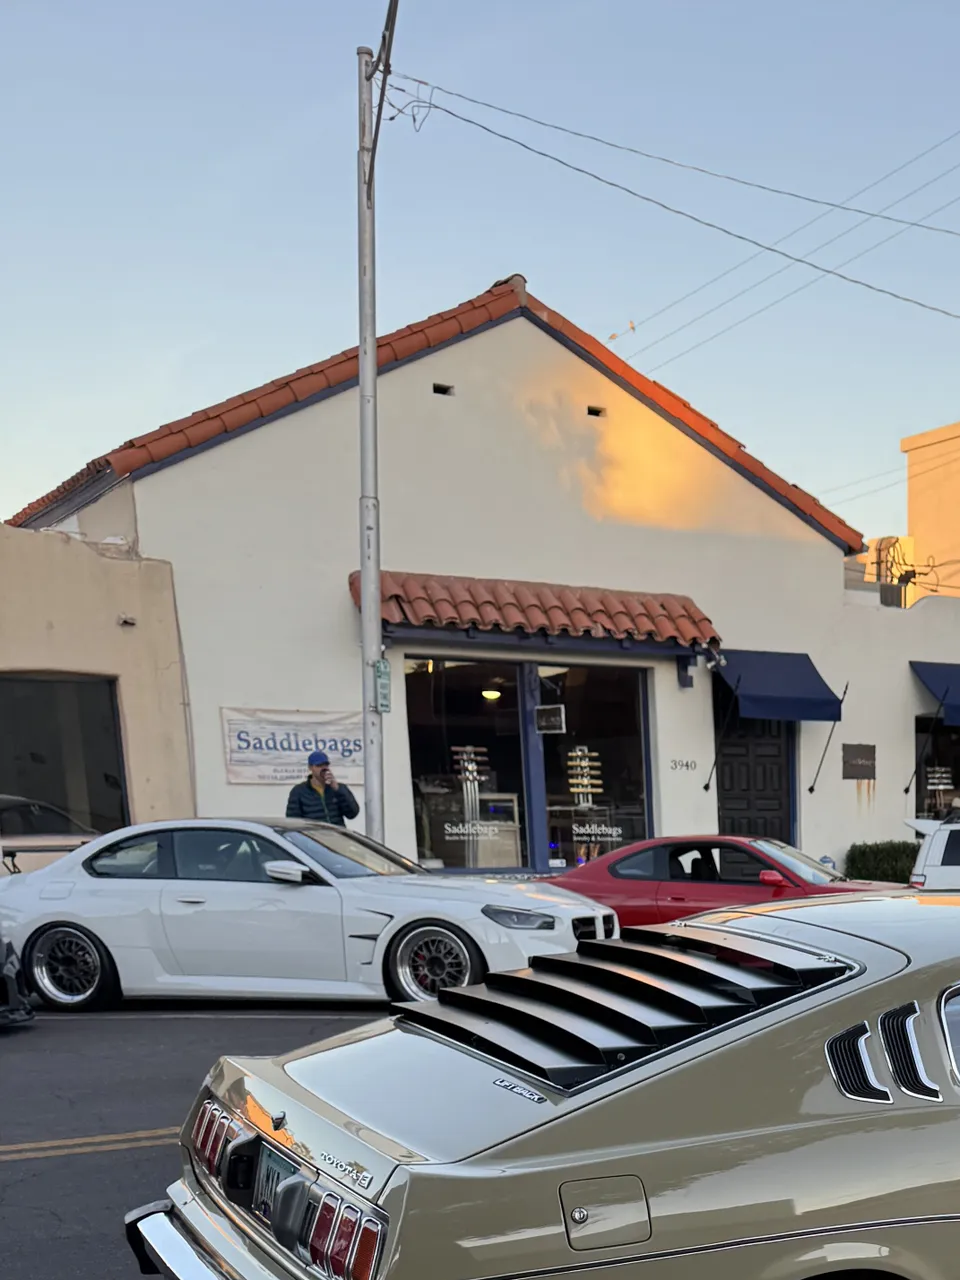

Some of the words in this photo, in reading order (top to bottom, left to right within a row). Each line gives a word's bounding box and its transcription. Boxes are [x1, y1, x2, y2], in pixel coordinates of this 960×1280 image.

[236, 730, 363, 758] Saddlebags
[670, 759, 697, 771] 3940
[444, 822, 499, 837] Saddlebags
[572, 823, 623, 837] Saddlebags
[320, 1150, 360, 1181] TOYOTA
